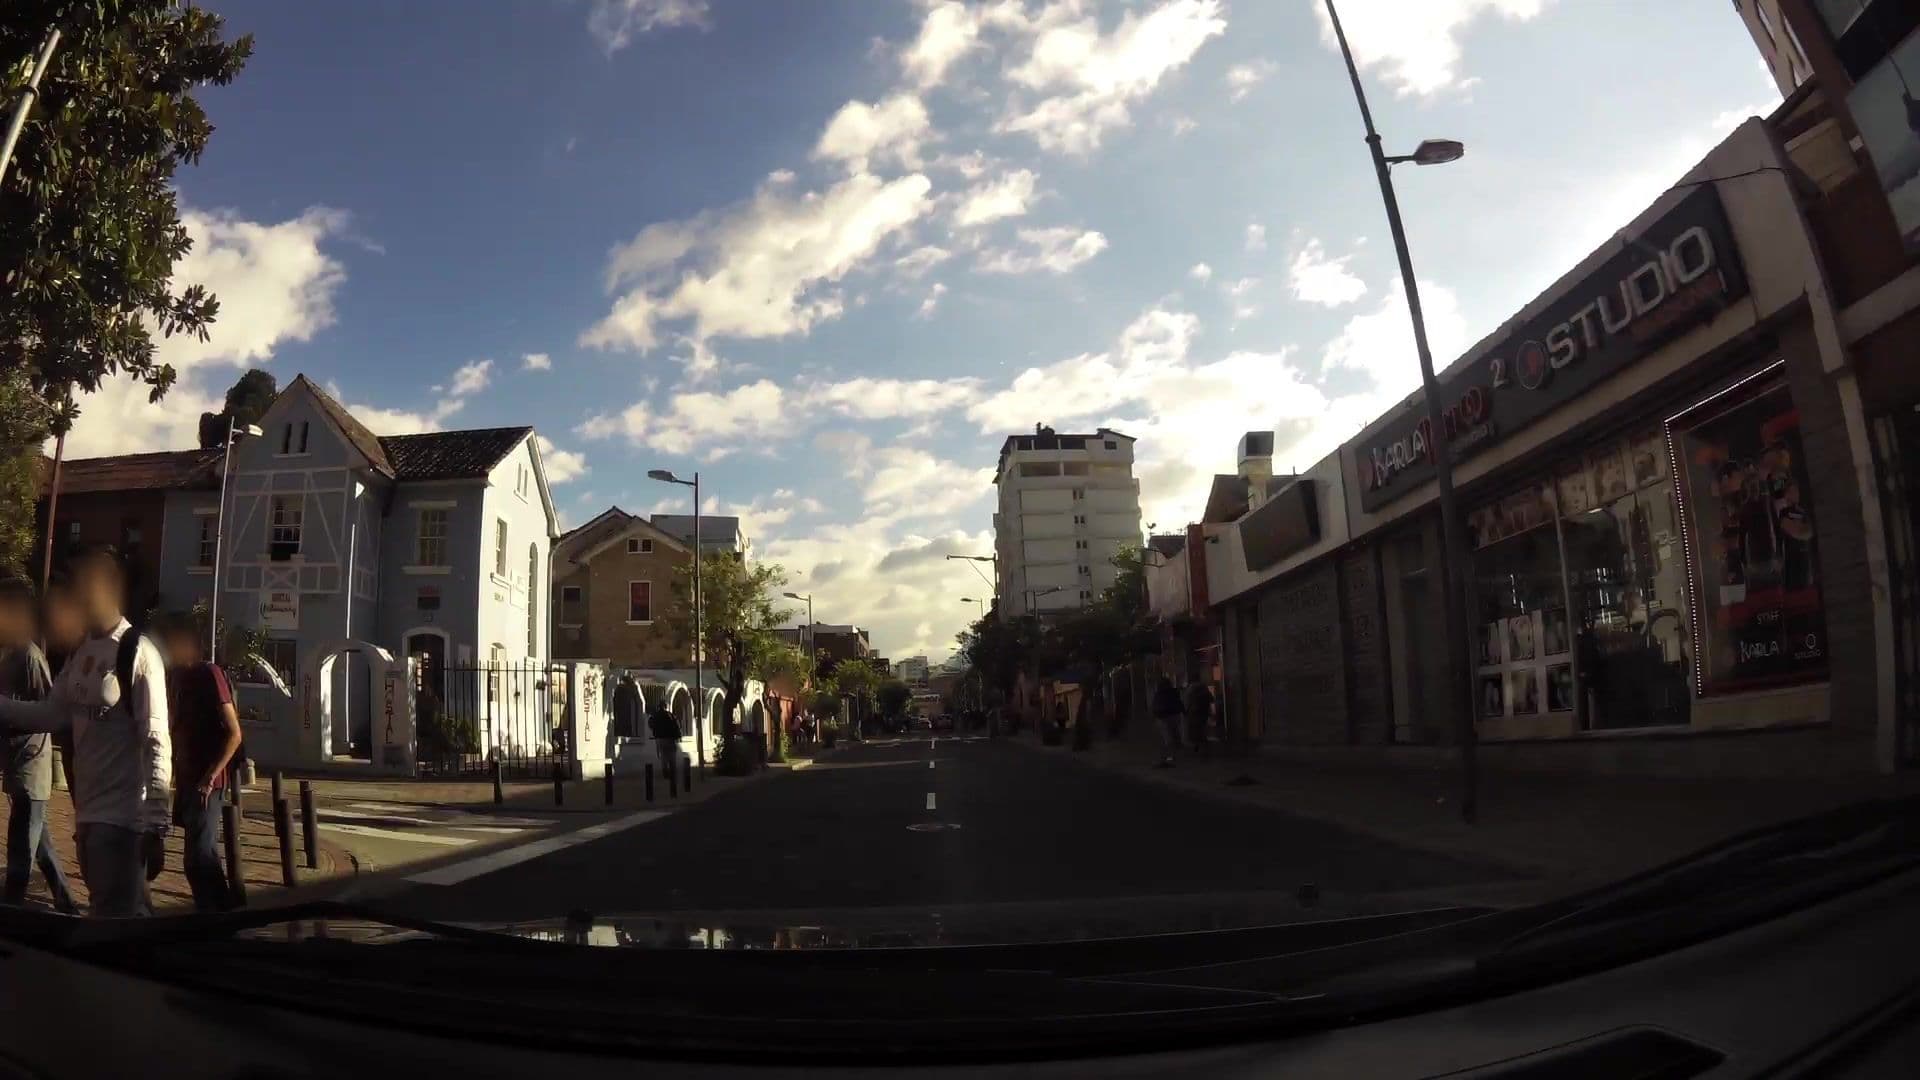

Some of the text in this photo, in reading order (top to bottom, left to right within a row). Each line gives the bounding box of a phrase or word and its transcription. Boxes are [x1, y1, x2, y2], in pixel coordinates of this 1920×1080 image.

[1372, 429, 1426, 487] KARLA
[1546, 226, 1713, 369] STUDIO
[384, 679, 394, 744] HOSTAL
